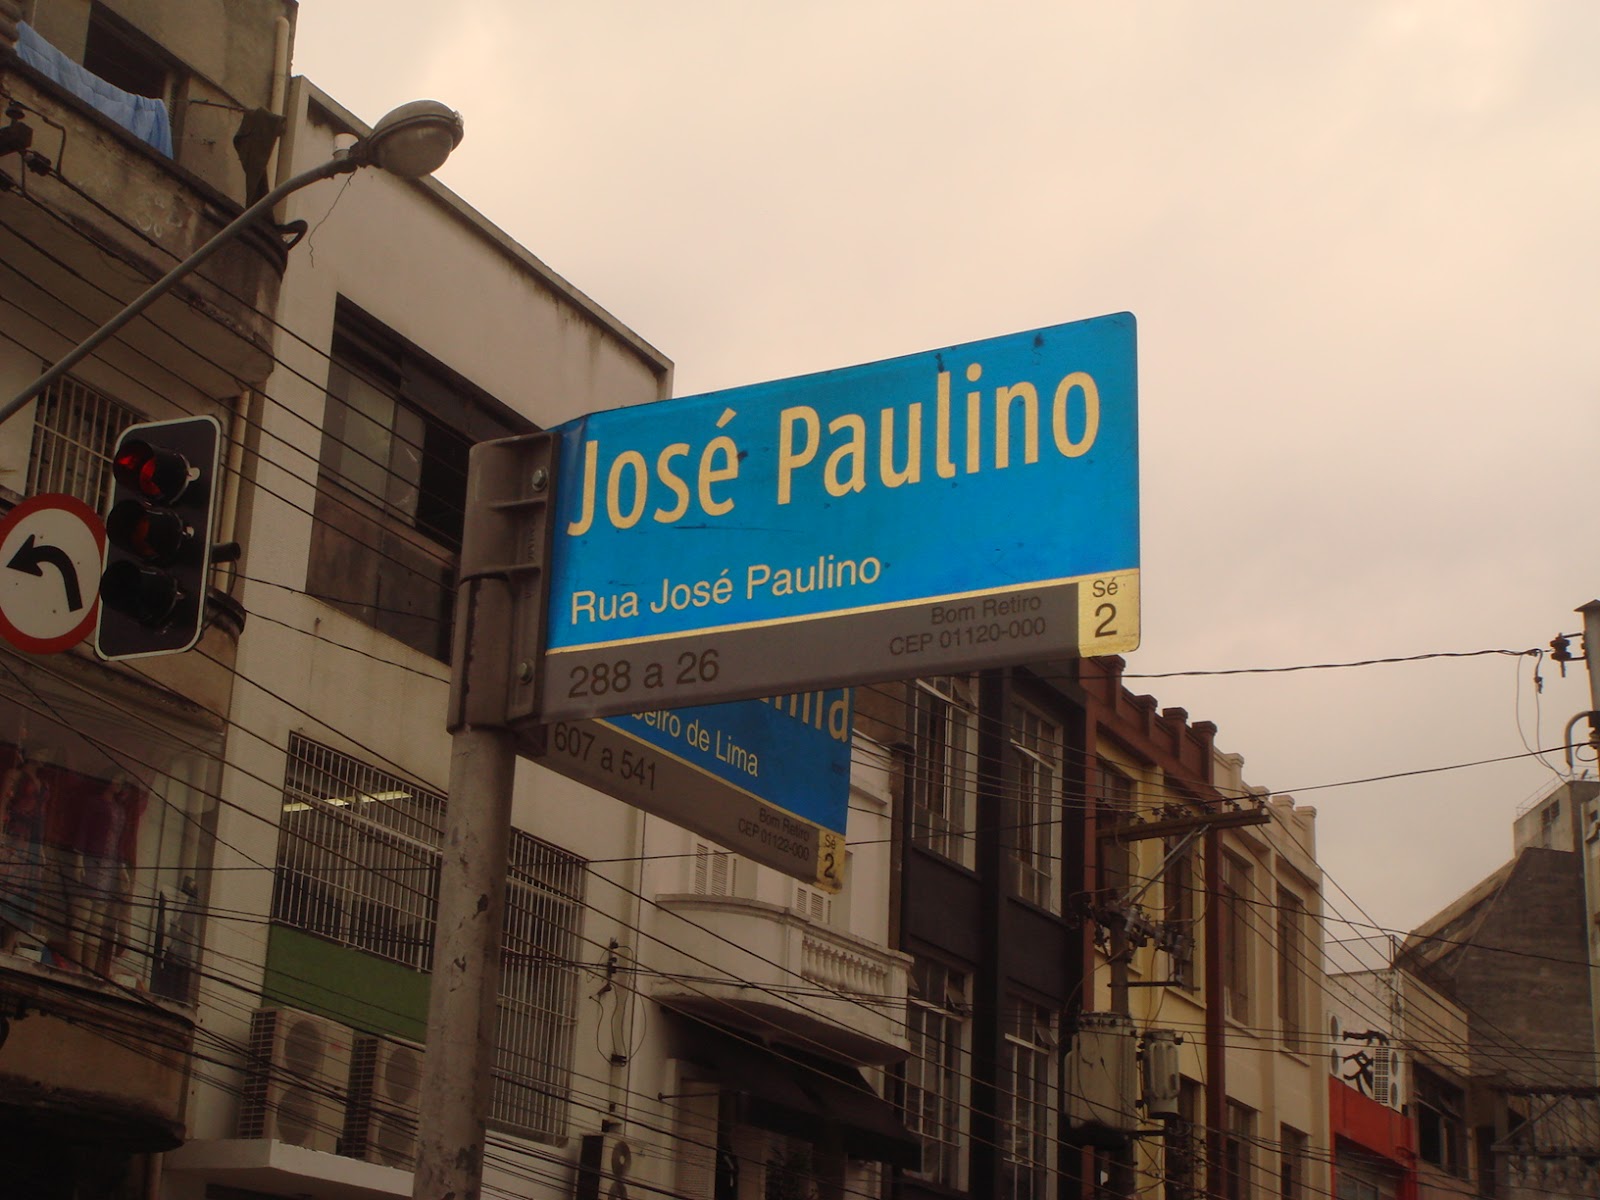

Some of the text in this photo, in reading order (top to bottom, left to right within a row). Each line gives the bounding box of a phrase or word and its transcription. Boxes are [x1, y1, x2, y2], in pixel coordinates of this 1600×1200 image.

[567, 363, 1100, 536] José Paulino
[571, 554, 881, 625] Rua José Paulino
[1092, 578, 1118, 598] Sé
[931, 595, 1042, 627] Bom Retiro
[1094, 602, 1117, 638] 2
[889, 617, 1046, 656] CEP 01120-000
[568, 649, 720, 698] 288 a 26
[554, 721, 656, 791] 607 a 541
[687, 719, 710, 752] de
[716, 730, 759, 777] Lima
[738, 818, 810, 862] CEP 01122-000
[759, 808, 810, 842] Bom Retiro
[824, 853, 835, 879] 2
